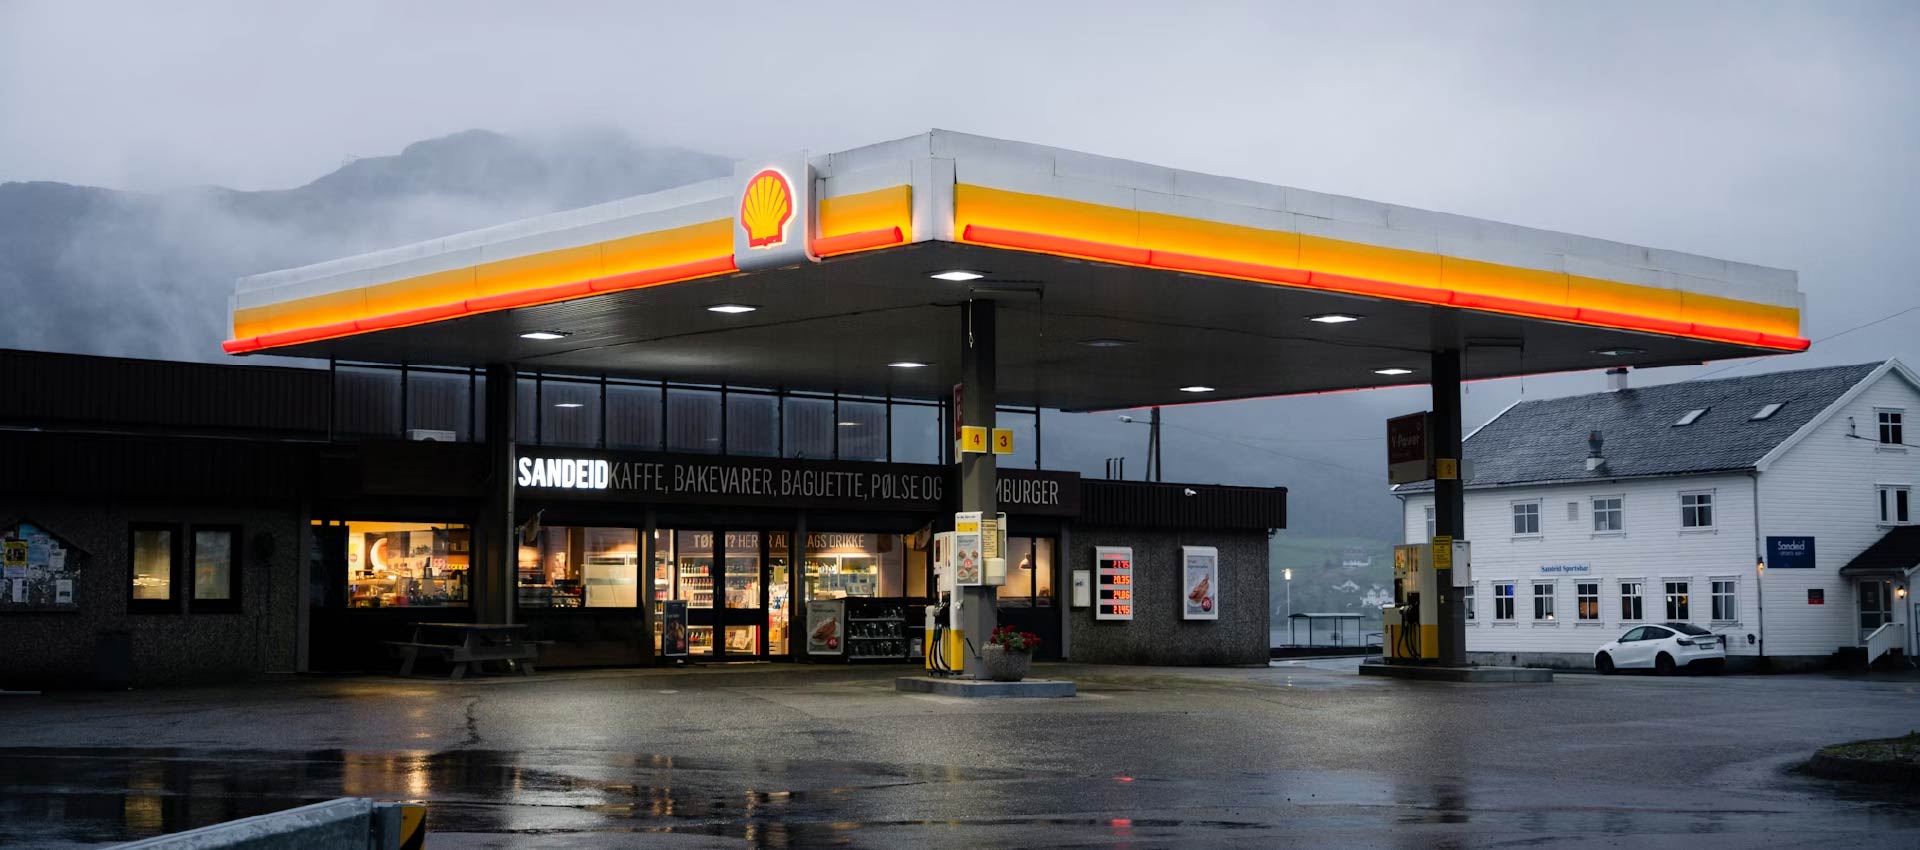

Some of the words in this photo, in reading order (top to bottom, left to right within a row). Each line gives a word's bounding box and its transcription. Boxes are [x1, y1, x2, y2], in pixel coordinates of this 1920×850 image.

[973, 434, 980, 445] 4
[1000, 435, 1008, 447] 3
[518, 457, 608, 489] SANDEID
[1446, 465, 1452, 474] 2
[608, 461, 668, 494] KAFFE,
[674, 464, 777, 497] BAKEVARER,
[780, 469, 867, 501] BAGUETTE,
[871, 473, 918, 500] PØLSE
[924, 476, 943, 501] OG
[738, 534, 758, 548] HER
[829, 534, 865, 548] DRIKKE
[1777, 540, 1805, 551] Sandeid
